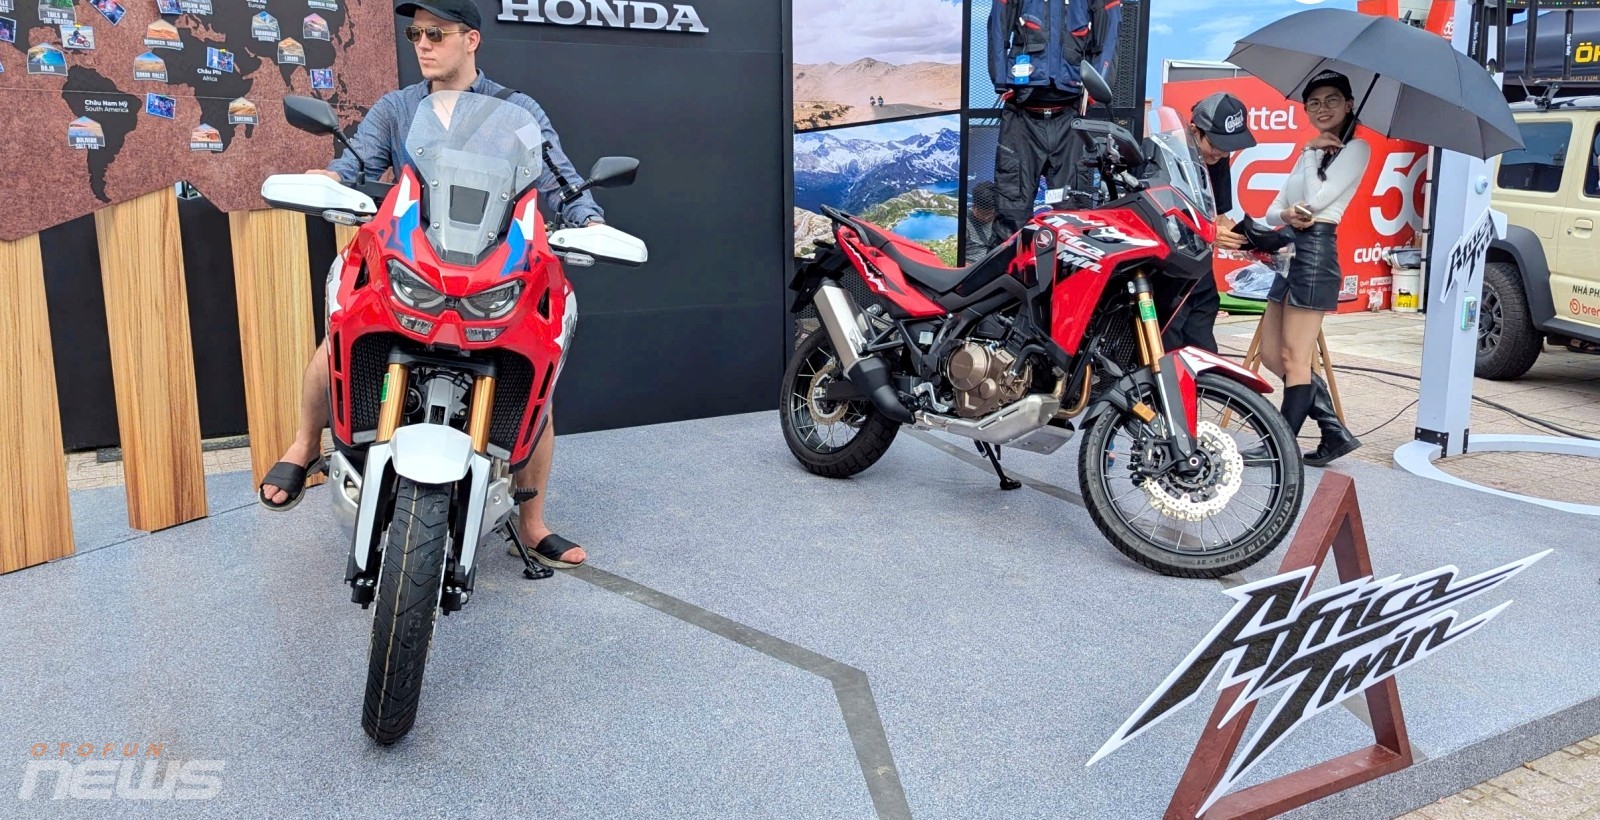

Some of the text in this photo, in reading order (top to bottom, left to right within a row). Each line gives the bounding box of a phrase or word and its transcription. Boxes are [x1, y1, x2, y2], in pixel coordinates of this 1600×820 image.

[498, 0, 709, 33] HONDA
[41, 64, 55, 72] BAJA
[1249, 105, 1298, 130] ttel
[1246, 499, 1293, 553] MICHELIN
[1122, 563, 1525, 740] Africa
[1229, 610, 1488, 783] Twin
